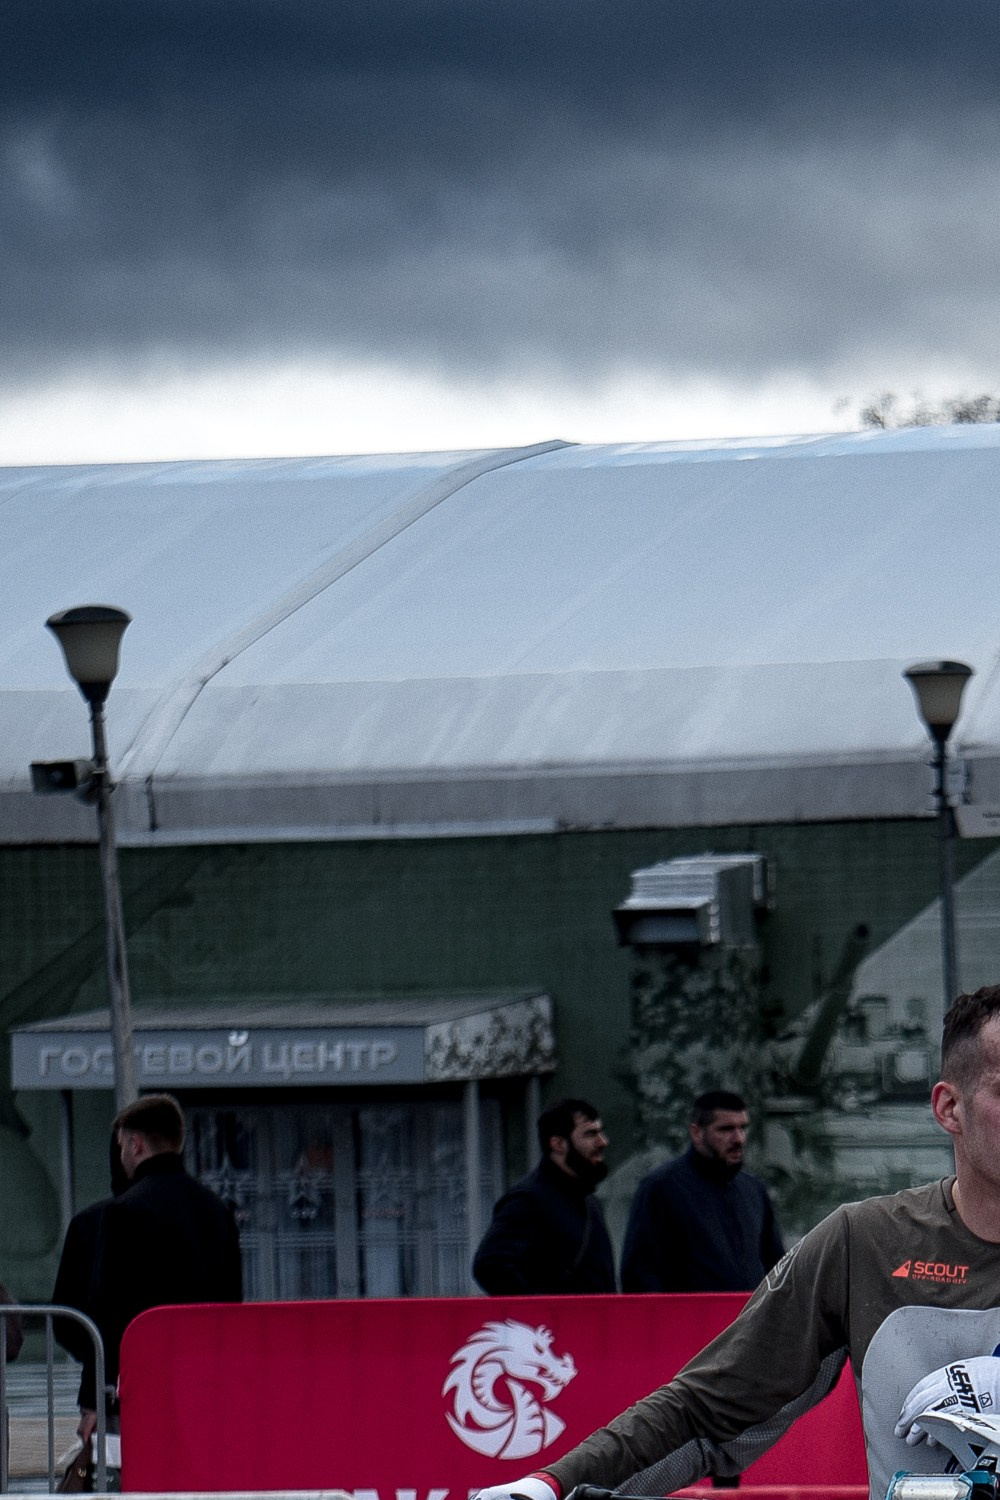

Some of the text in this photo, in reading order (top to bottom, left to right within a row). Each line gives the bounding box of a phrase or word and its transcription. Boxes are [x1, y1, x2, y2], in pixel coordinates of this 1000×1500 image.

[39, 1031, 398, 1079] ГОСЕВОЙ ЦЕНТР
[913, 1260, 970, 1278] SCOUT
[949, 1364, 982, 1413] LEATT
